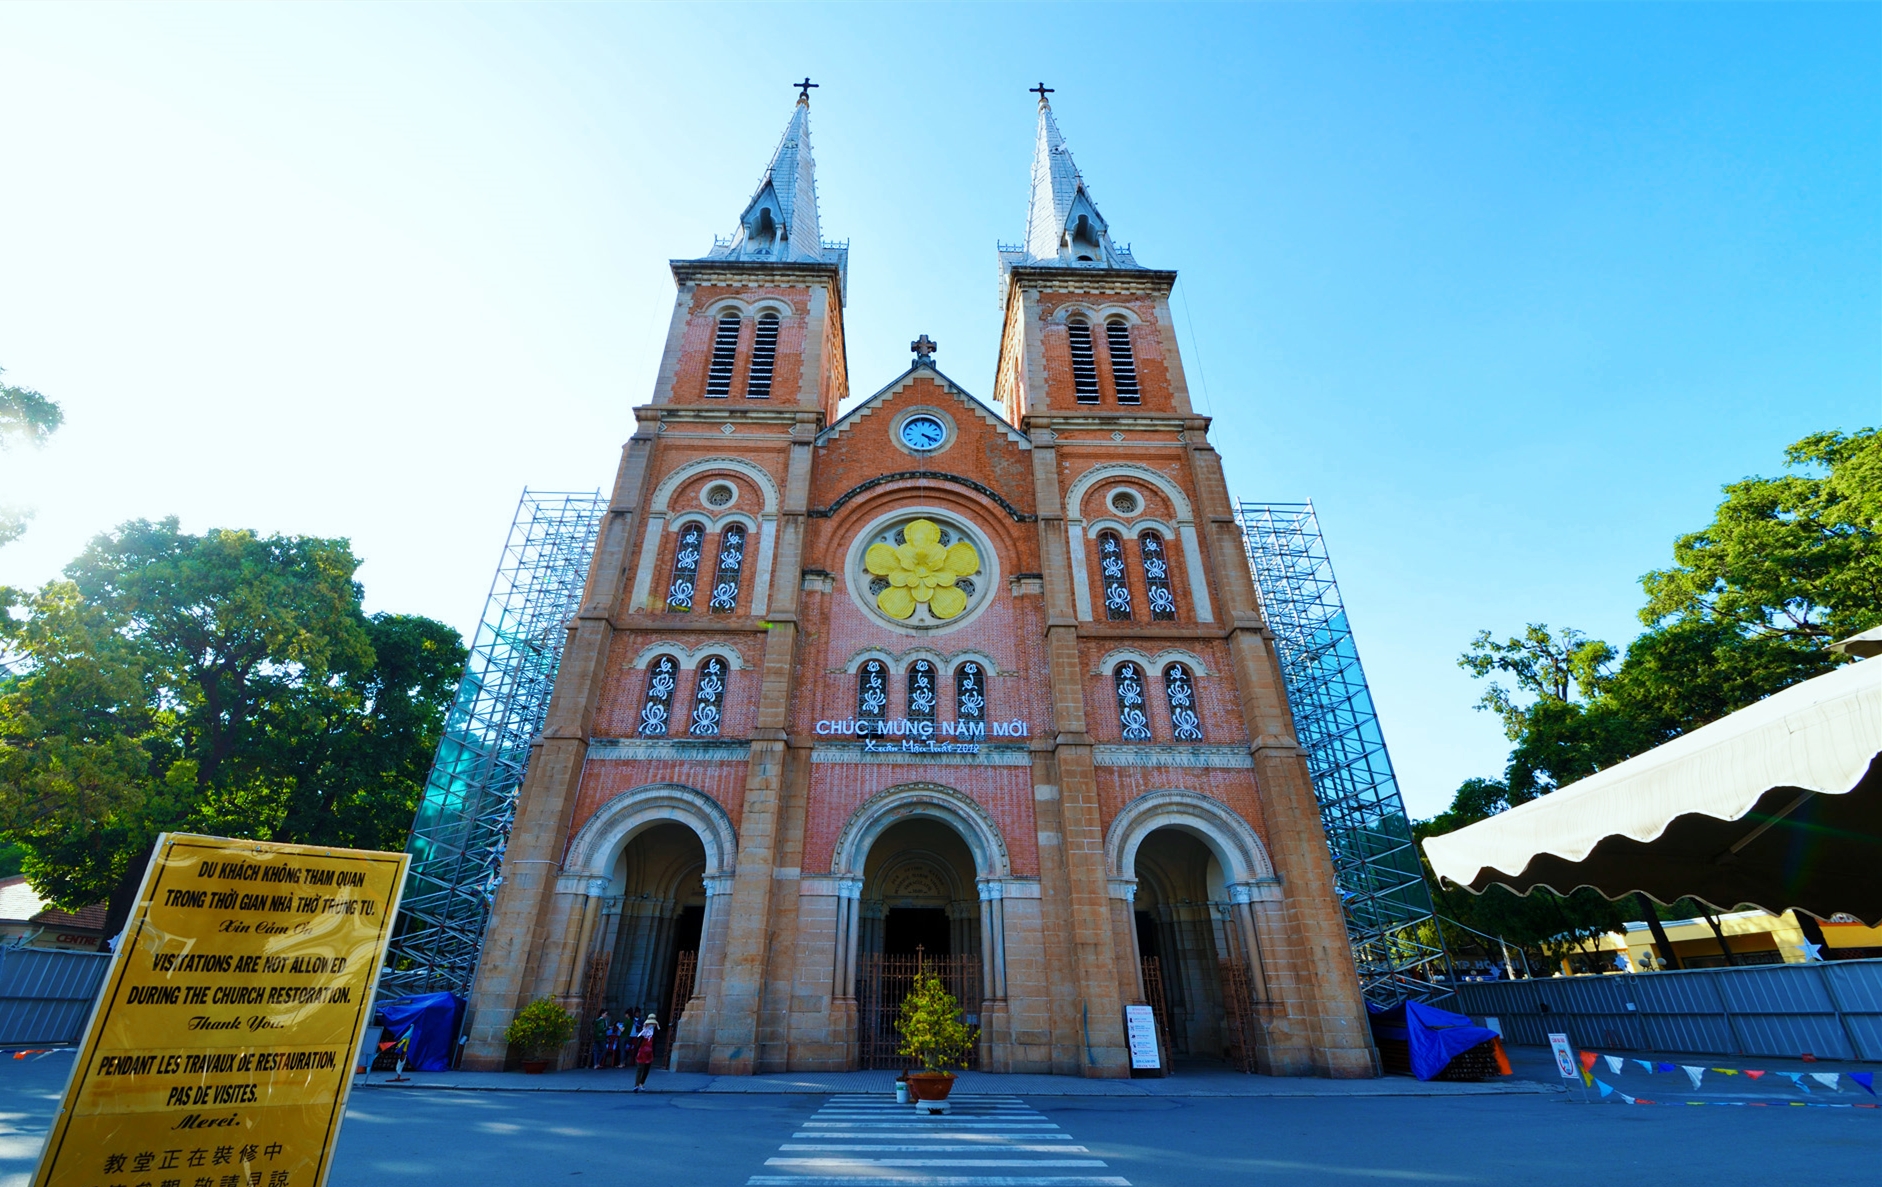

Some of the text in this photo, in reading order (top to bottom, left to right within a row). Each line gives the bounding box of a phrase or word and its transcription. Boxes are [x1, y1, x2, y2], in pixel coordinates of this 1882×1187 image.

[815, 716, 1028, 737] CHÚC MỪNG NĂM MỚI
[956, 743, 980, 754] 2018
[198, 860, 366, 889] DU KHÁCH KHÔNG THAM QUAN
[164, 889, 207, 908] TRONG
[208, 888, 239, 909] THỜI
[239, 894, 269, 911] GIAN
[268, 893, 294, 913] NHÀ
[296, 894, 321, 914] THỜ
[359, 899, 375, 916] TU.
[219, 919, 251, 933] Xin
[57, 933, 98, 946] CENTRE
[151, 953, 348, 974] VISITATIONS ARE NOT ALLOWED
[126, 986, 351, 1005] DURING THE CHURCH RESTORATION.
[187, 1016, 242, 1031] Thank
[97, 1051, 337, 1076] PENDANT LES TRAVAUX DE RESTAURATION,
[166, 1083, 259, 1107] PAS DE VISITES.
[171, 1113, 241, 1131] Merci.
[103, 1141, 283, 1175] 教堂正在裝修中
